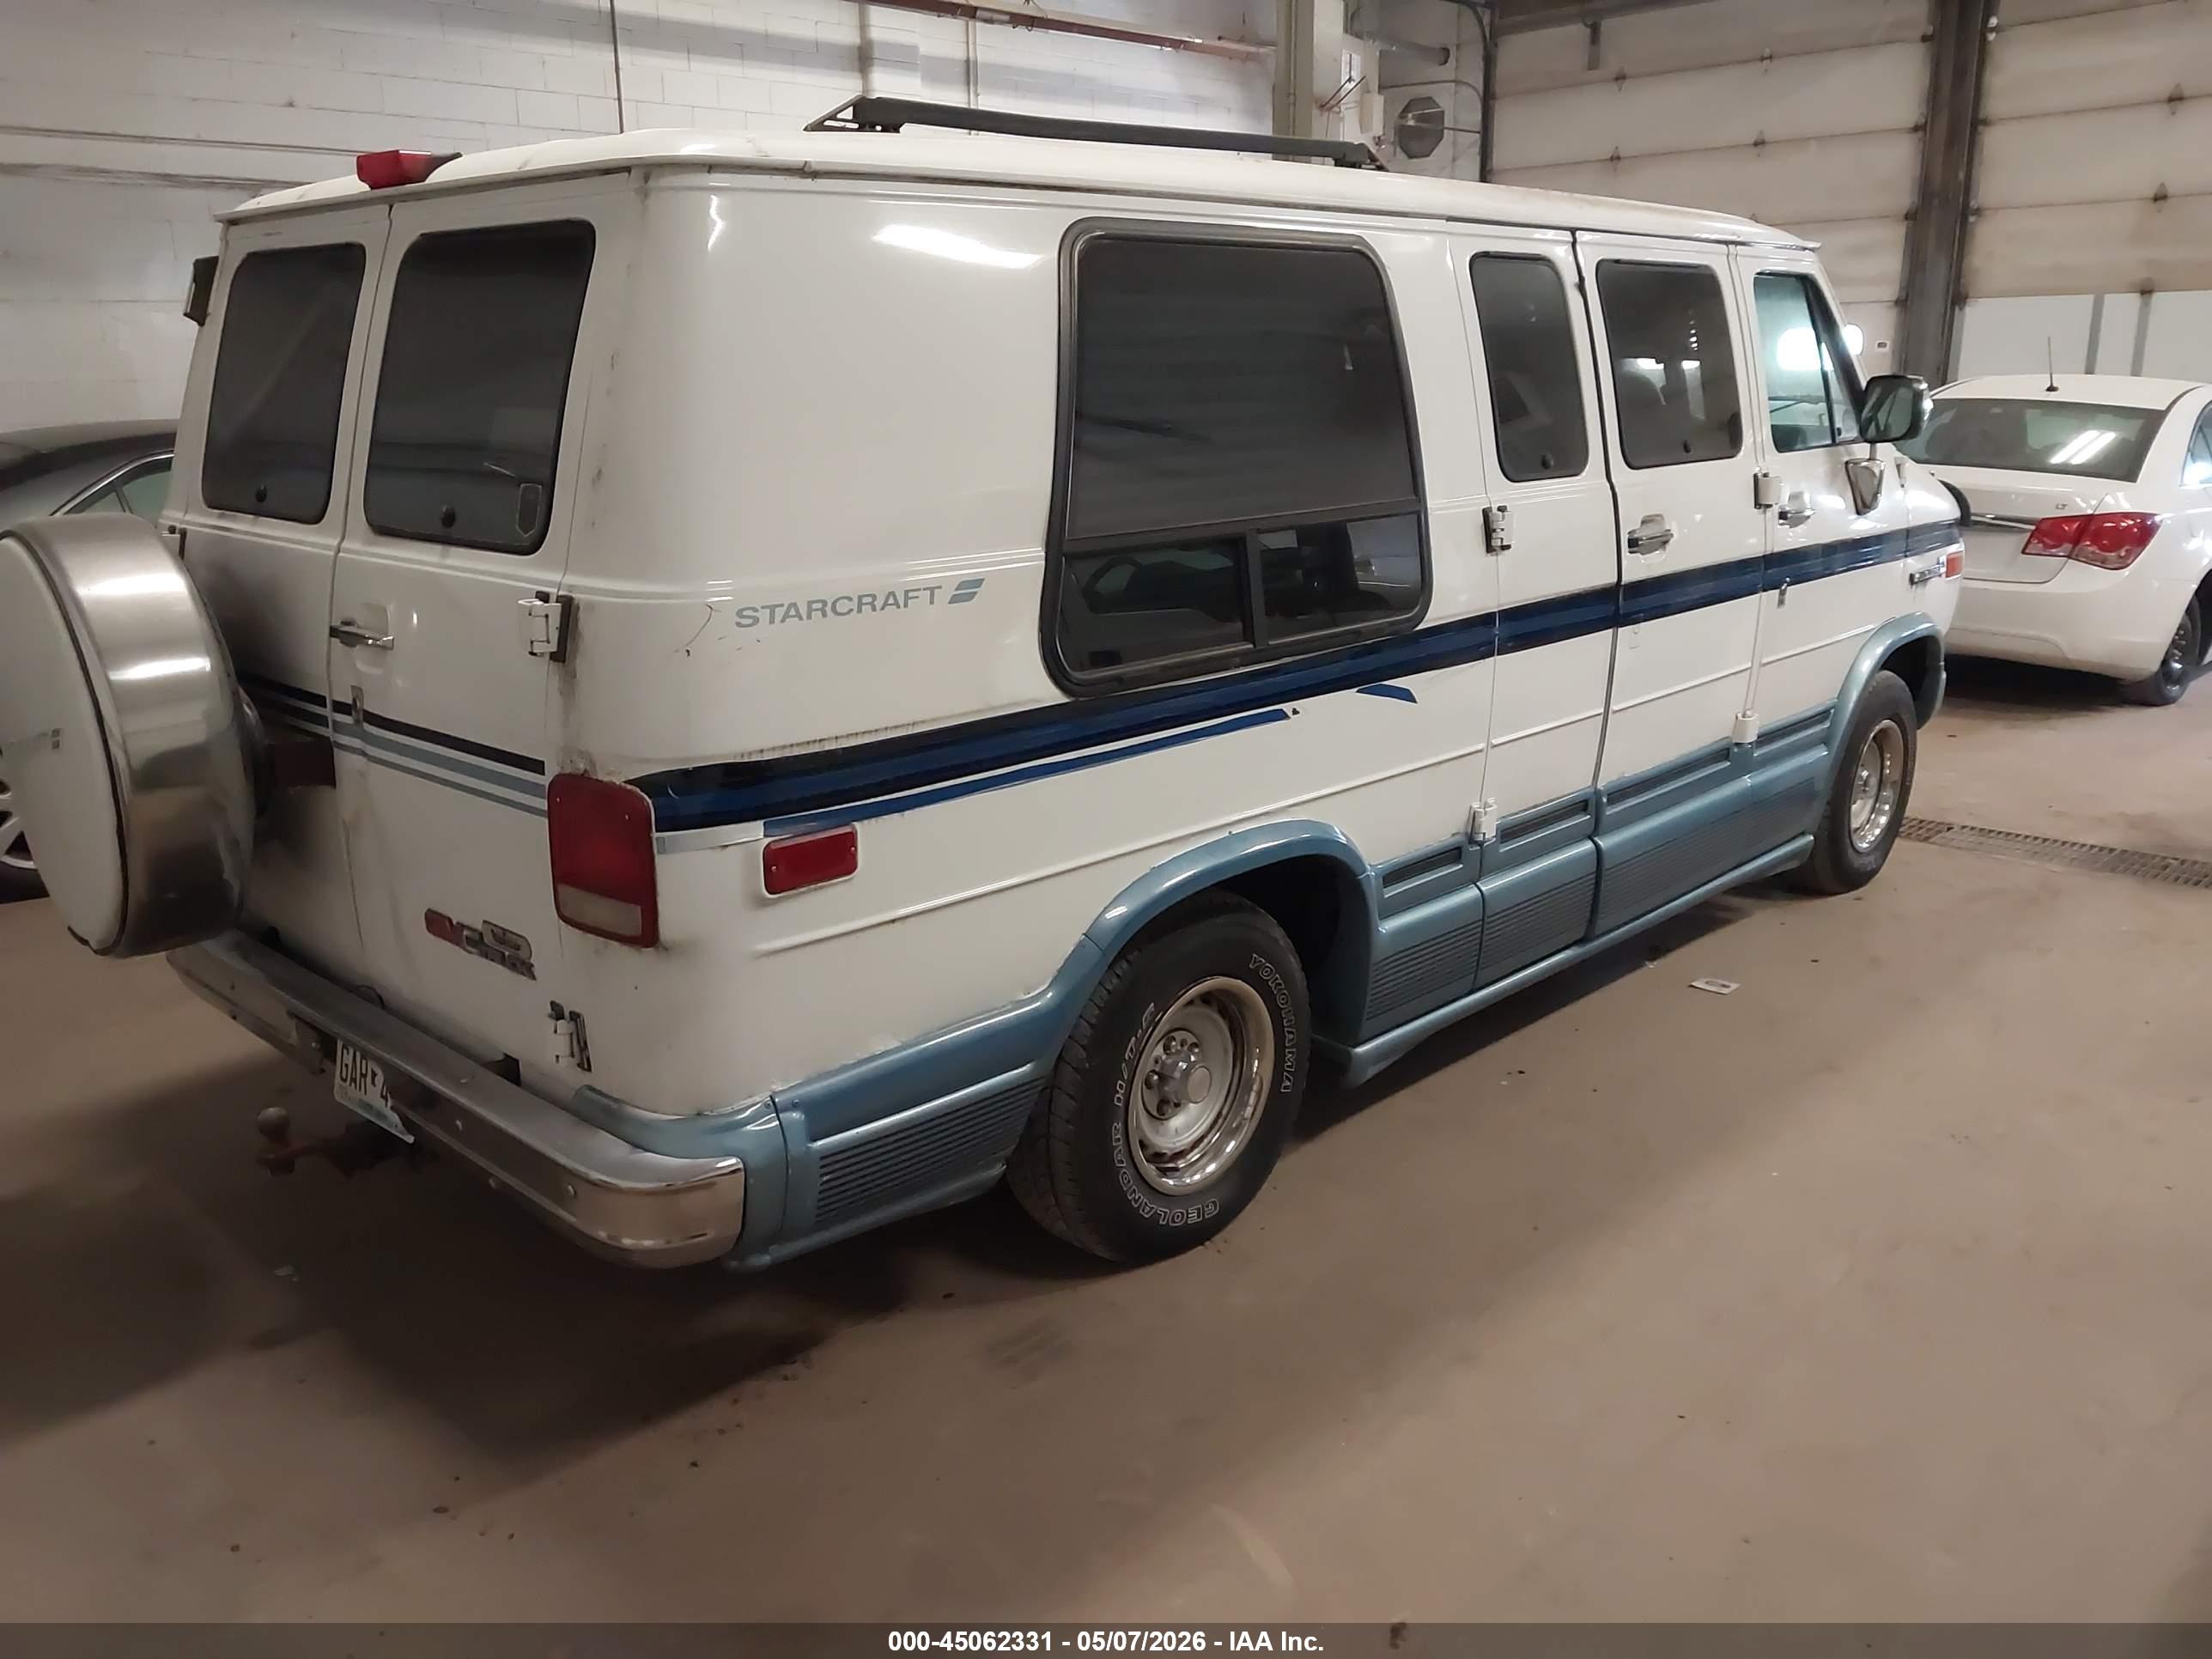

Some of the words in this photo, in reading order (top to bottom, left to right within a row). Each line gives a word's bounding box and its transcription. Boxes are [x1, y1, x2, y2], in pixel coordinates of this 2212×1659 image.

[735, 586, 942, 629] STARCRAFT
[1249, 953, 1297, 1092] YOKOHAMA
[1112, 1121, 1219, 1226] GEOLANDAR
